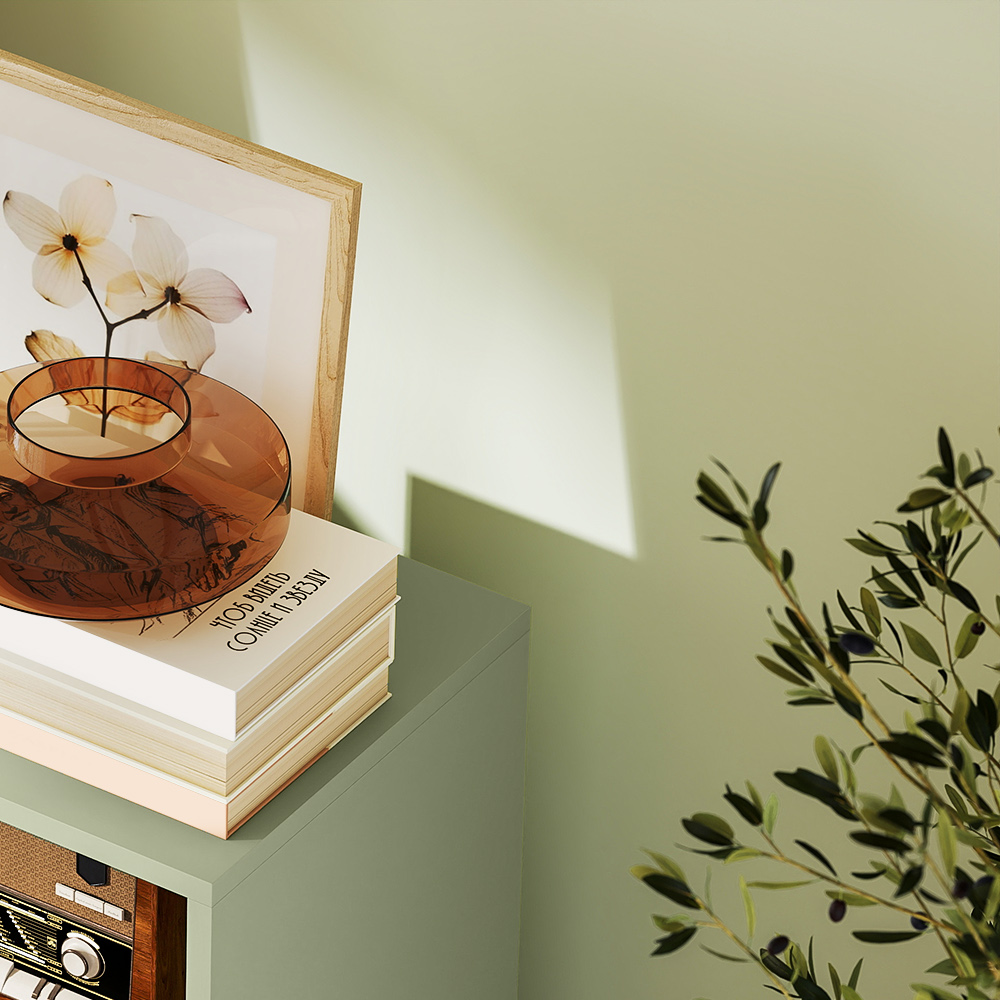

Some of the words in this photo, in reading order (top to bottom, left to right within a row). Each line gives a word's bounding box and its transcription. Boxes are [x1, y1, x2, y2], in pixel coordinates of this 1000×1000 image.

[209, 601, 254, 630] ЧТОБ
[242, 572, 291, 604] ВИДЕТЬ
[227, 610, 283, 652] СОЛНЦЕ
[280, 568, 331, 606] ЗВЕЗДУ
